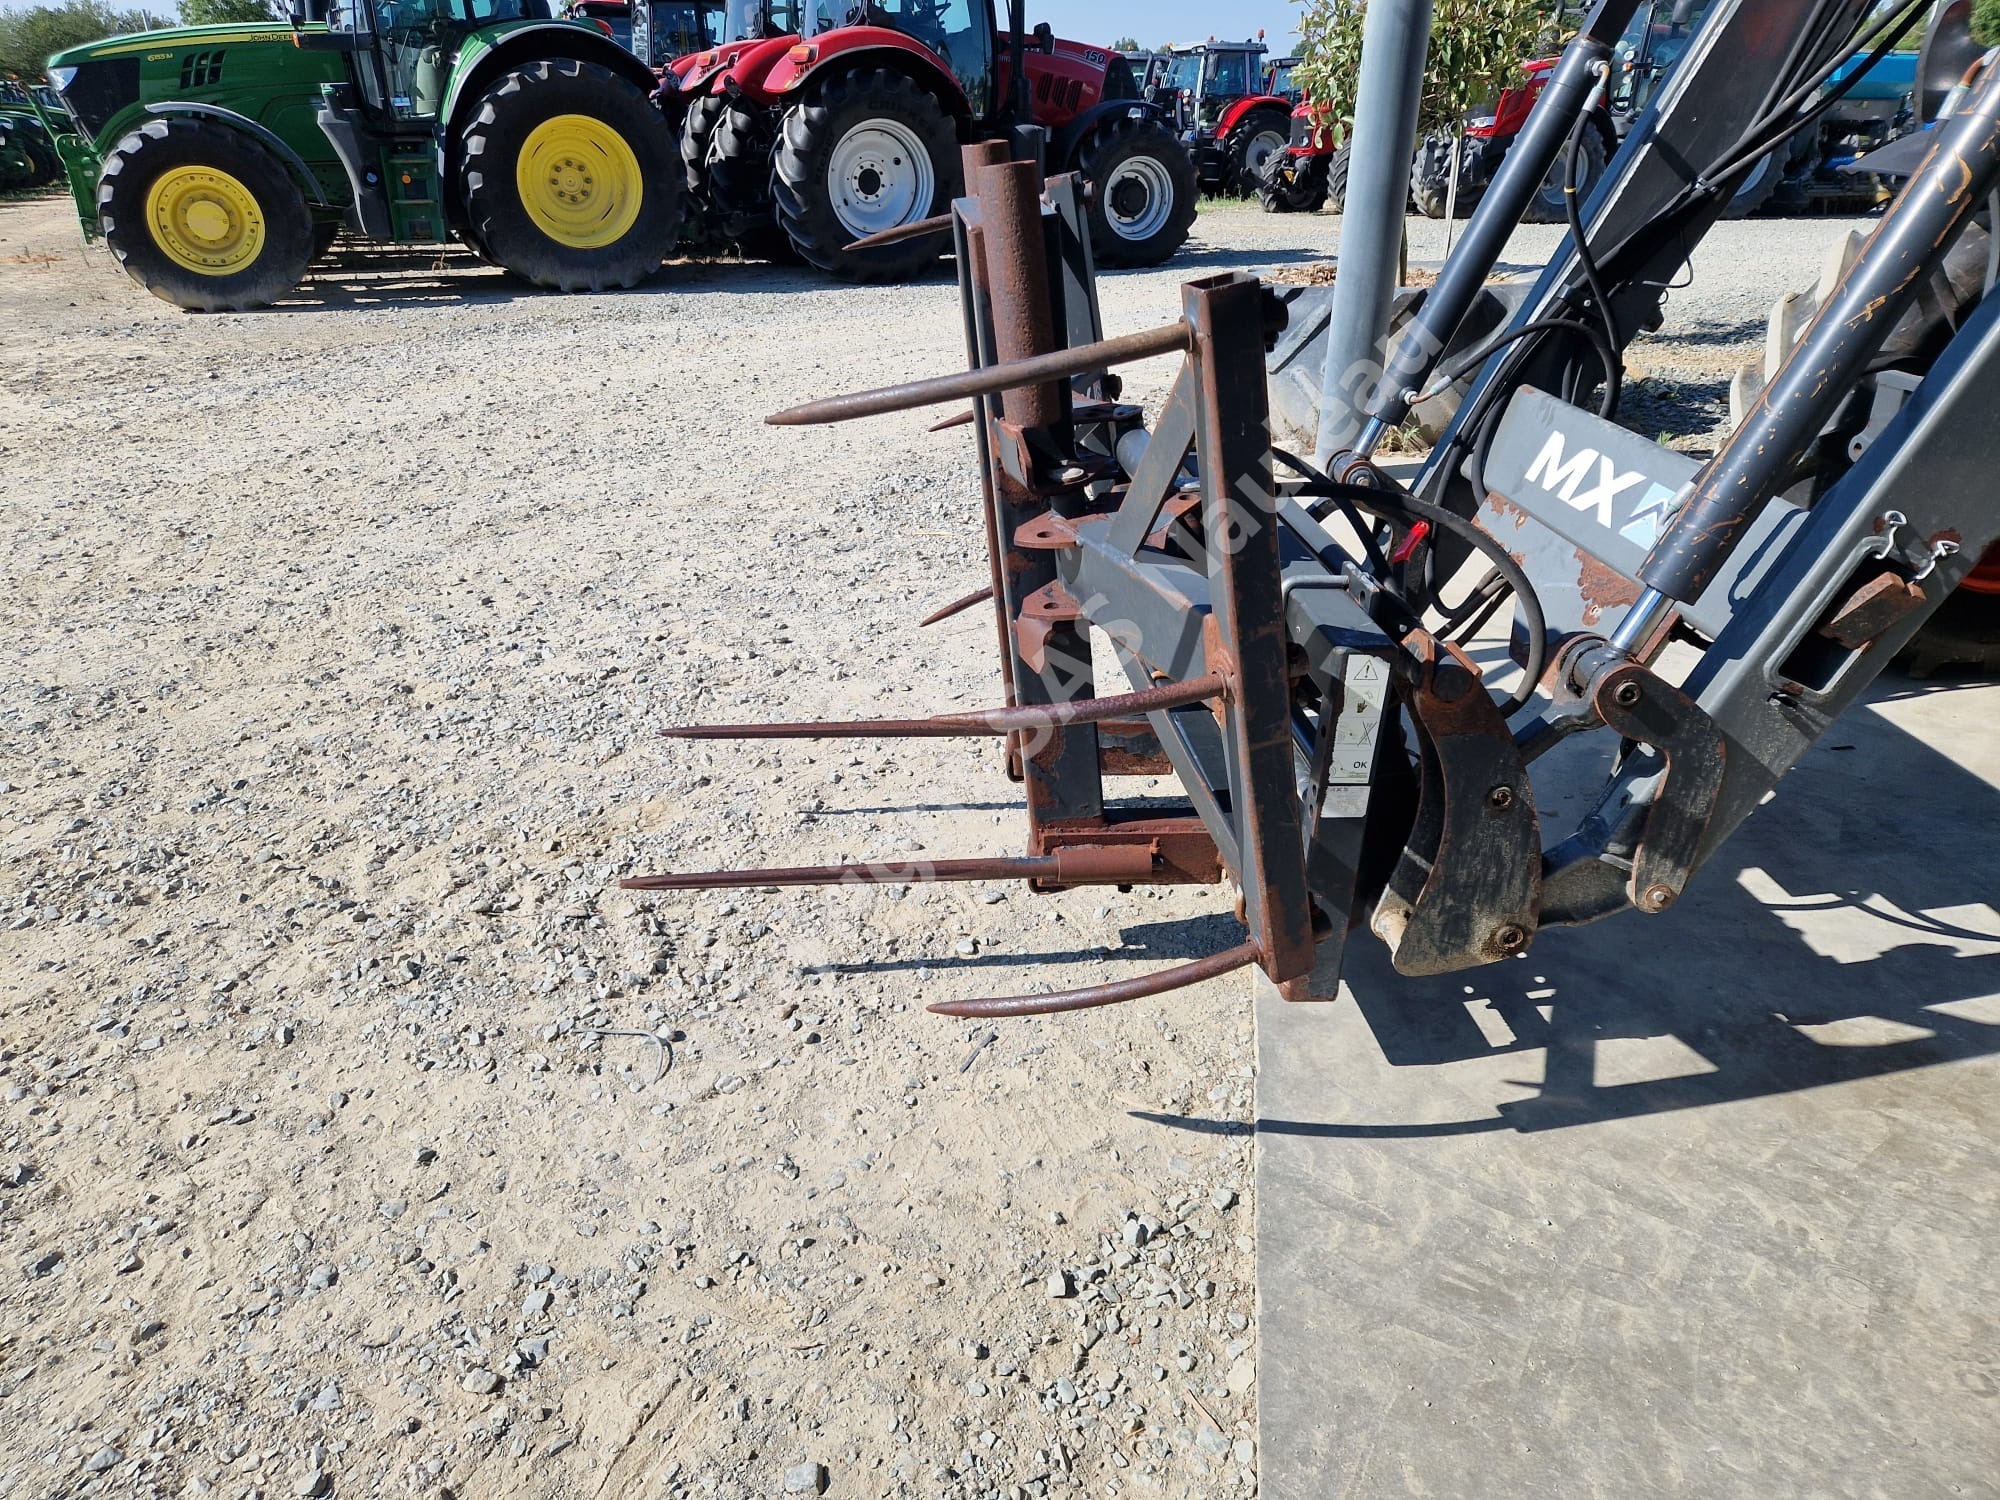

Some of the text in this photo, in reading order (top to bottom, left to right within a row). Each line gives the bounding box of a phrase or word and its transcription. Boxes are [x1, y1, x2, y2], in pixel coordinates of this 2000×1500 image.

[250, 33, 271, 42] JOHN
[1084, 49, 1106, 65] 150
[1524, 430, 1647, 529] MX
[1353, 761, 1368, 769] OK
